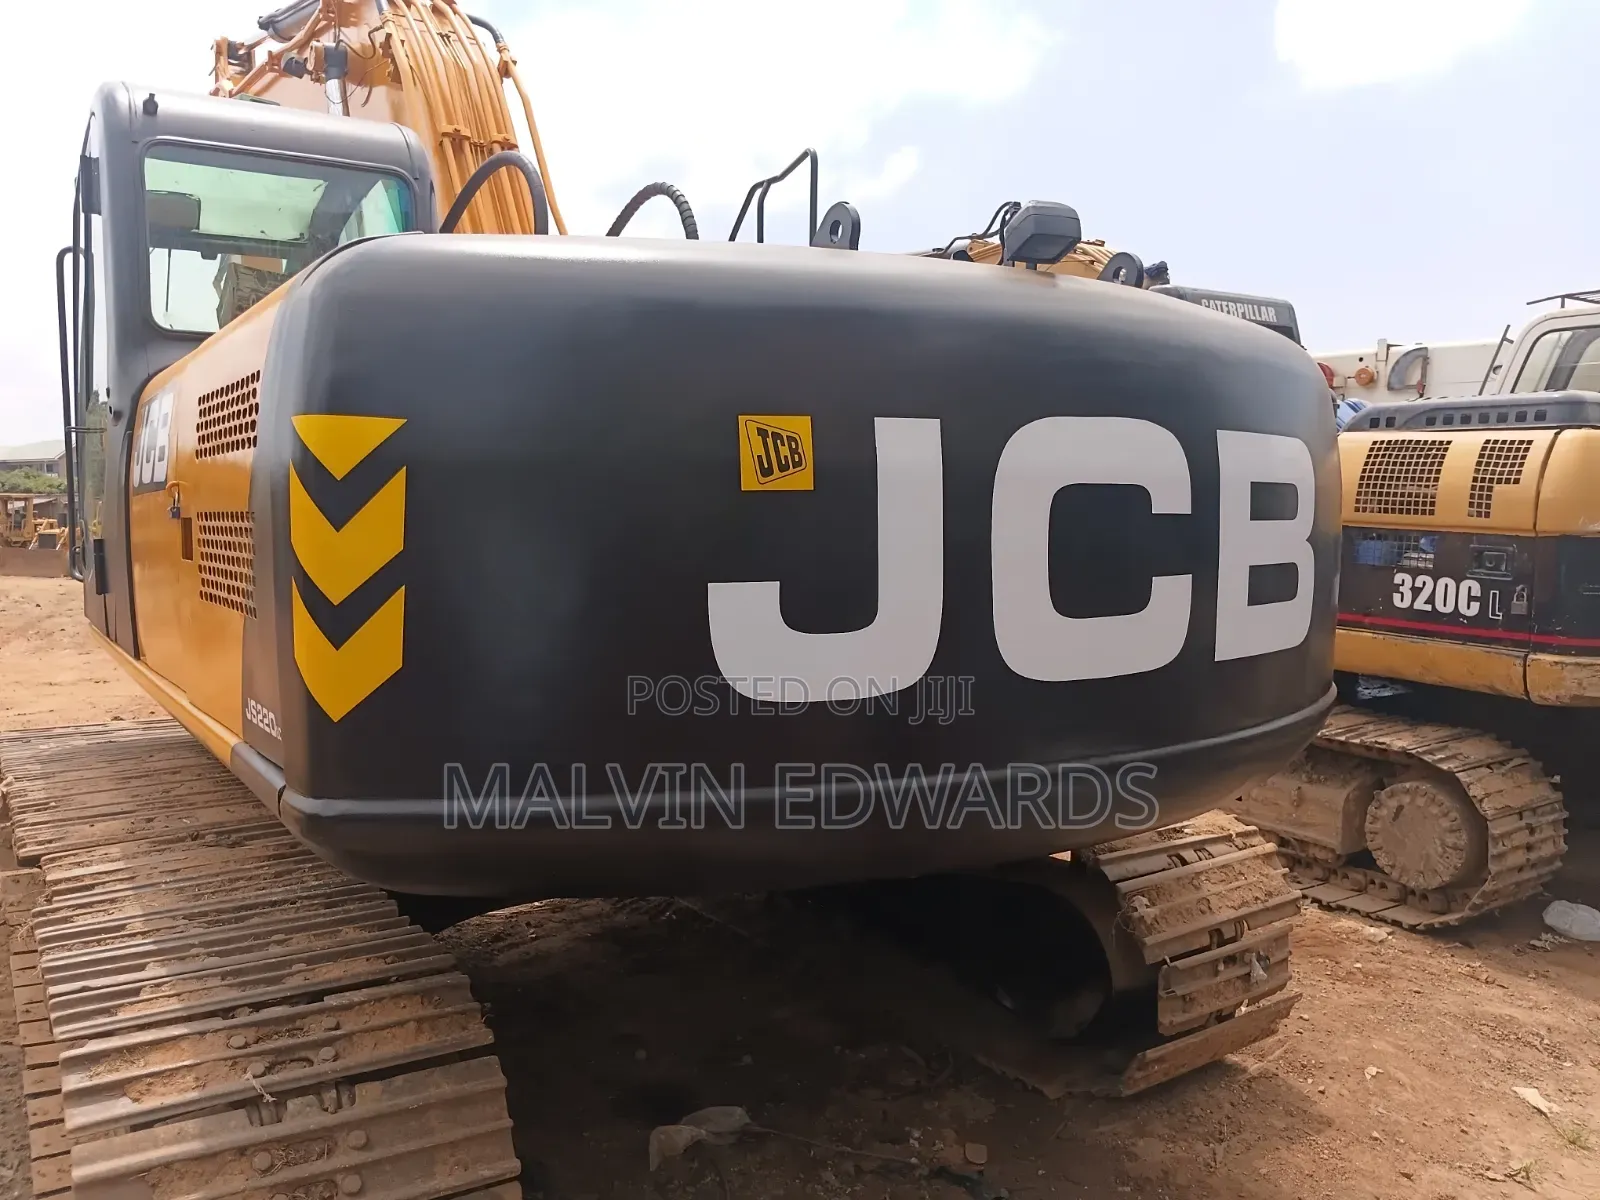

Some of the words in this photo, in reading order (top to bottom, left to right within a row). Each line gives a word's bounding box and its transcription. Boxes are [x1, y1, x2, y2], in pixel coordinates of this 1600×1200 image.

[133, 392, 174, 488] JCB
[756, 426, 803, 478] JCB
[707, 416, 1315, 703] JCB
[1392, 572, 1481, 617] 320C
